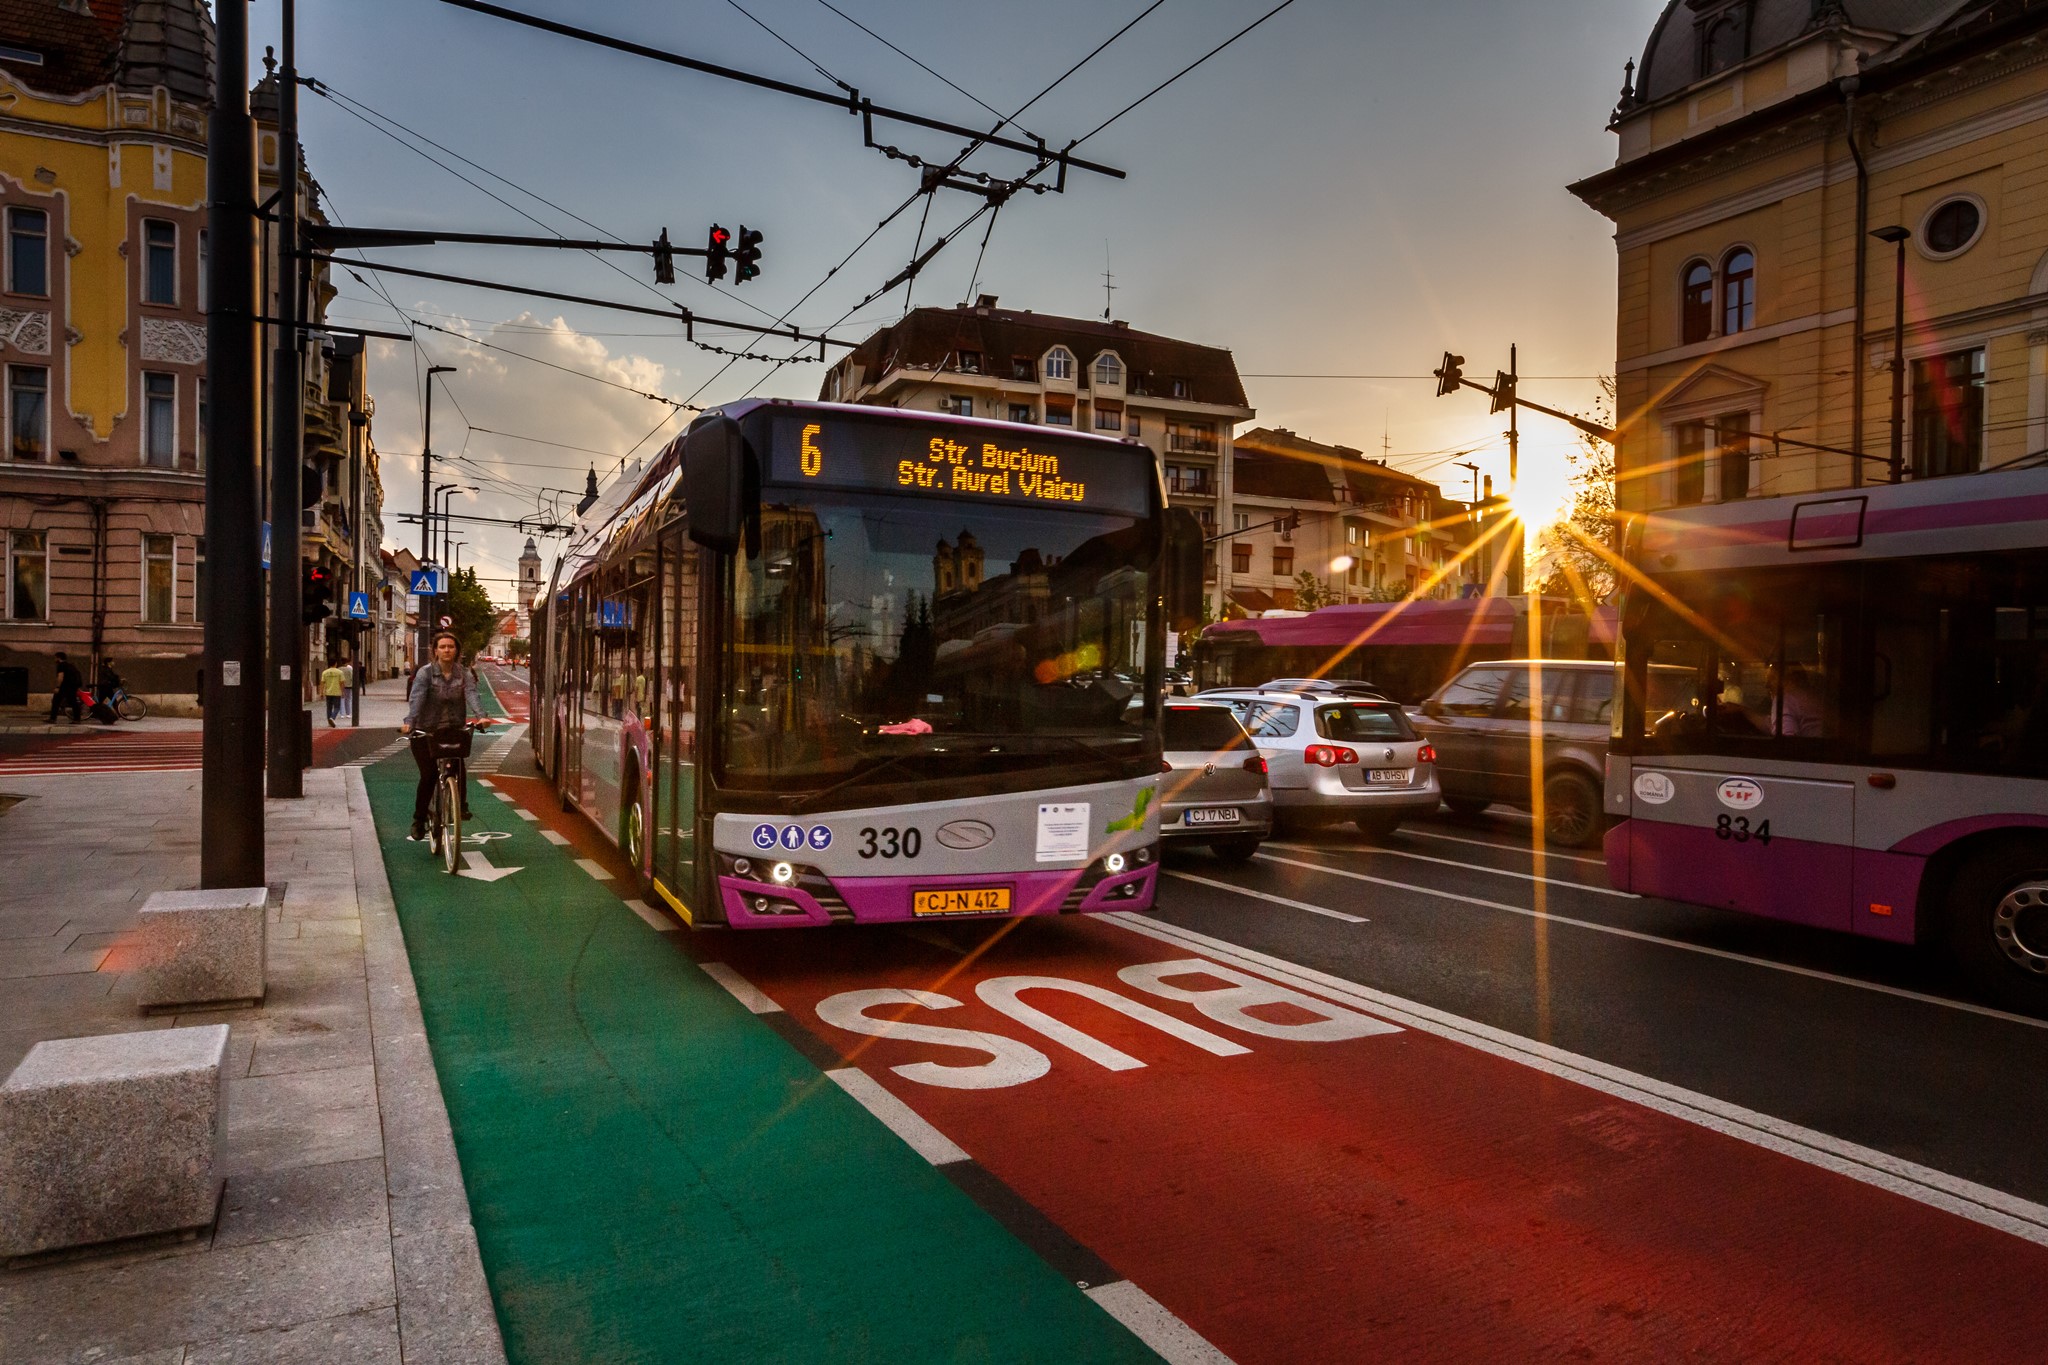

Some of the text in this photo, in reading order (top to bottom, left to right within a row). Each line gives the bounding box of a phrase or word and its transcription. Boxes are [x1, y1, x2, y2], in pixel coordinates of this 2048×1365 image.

[801, 424, 821, 476] 6
[929, 437, 1058, 475] Str. Bucium
[898, 460, 1085, 501] Str. Aurel Vlaicu
[1193, 809, 1237, 821] CJ 17 NBA
[1715, 813, 1771, 847] 834
[858, 827, 922, 859] 330
[928, 891, 999, 910] CJ-N 412
[815, 957, 1407, 1090] BUS
